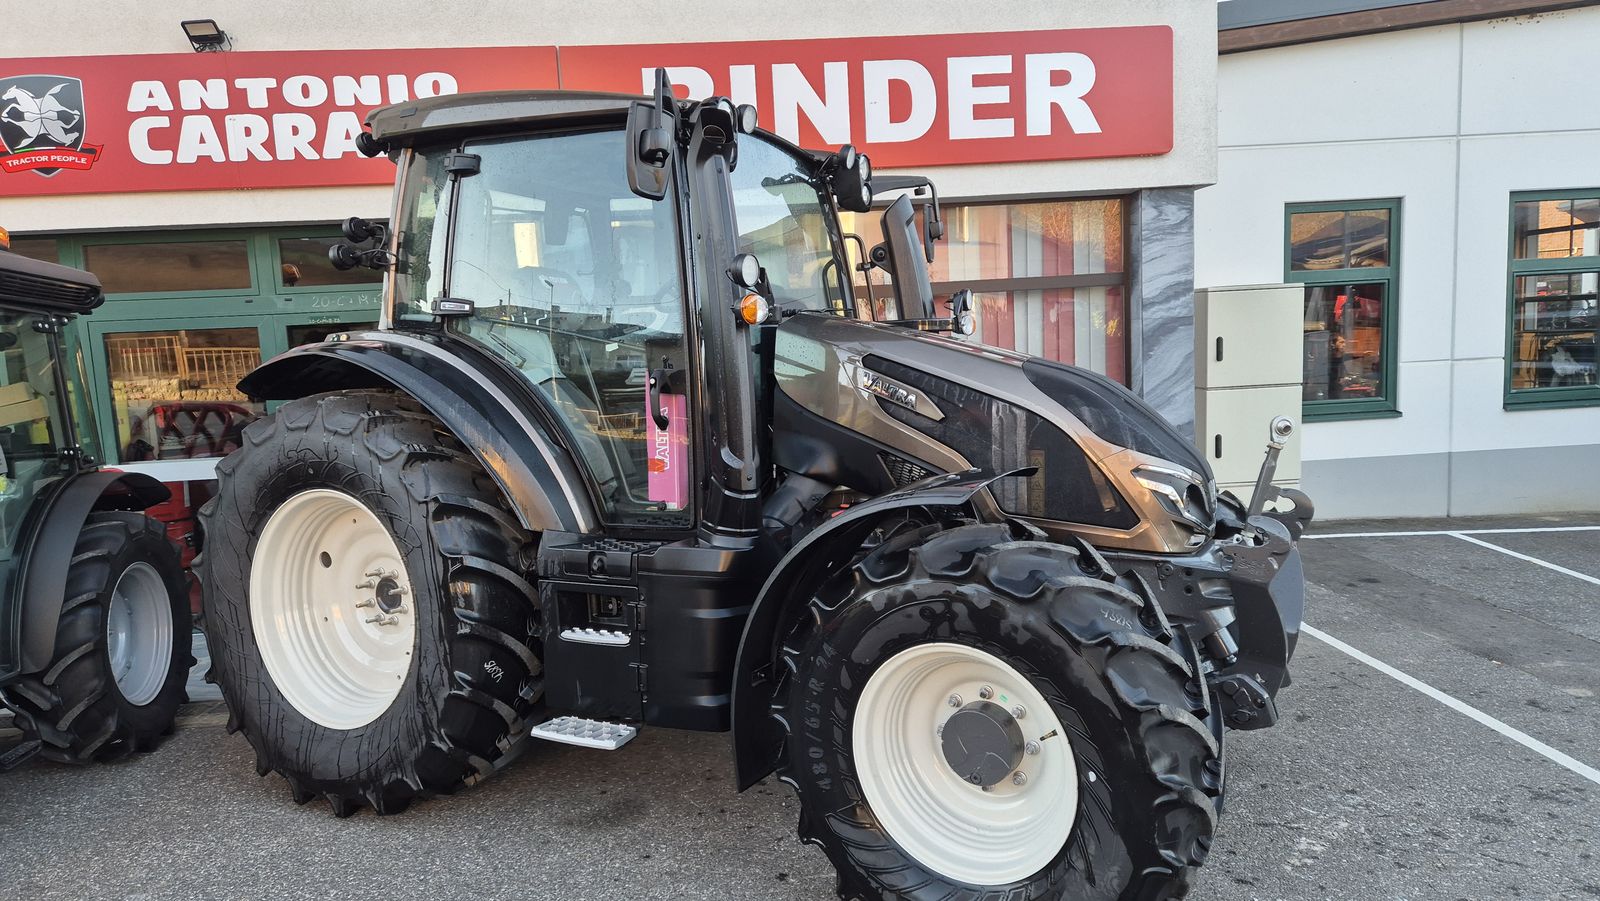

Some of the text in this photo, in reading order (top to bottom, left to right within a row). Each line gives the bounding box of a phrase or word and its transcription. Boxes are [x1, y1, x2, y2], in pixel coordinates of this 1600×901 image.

[127, 72, 458, 112] ANTONIO
[6, 156, 87, 168] TRACTOR PEOPLE
[863, 369, 917, 411] VALTRA
[654, 406, 670, 474] VALTA
